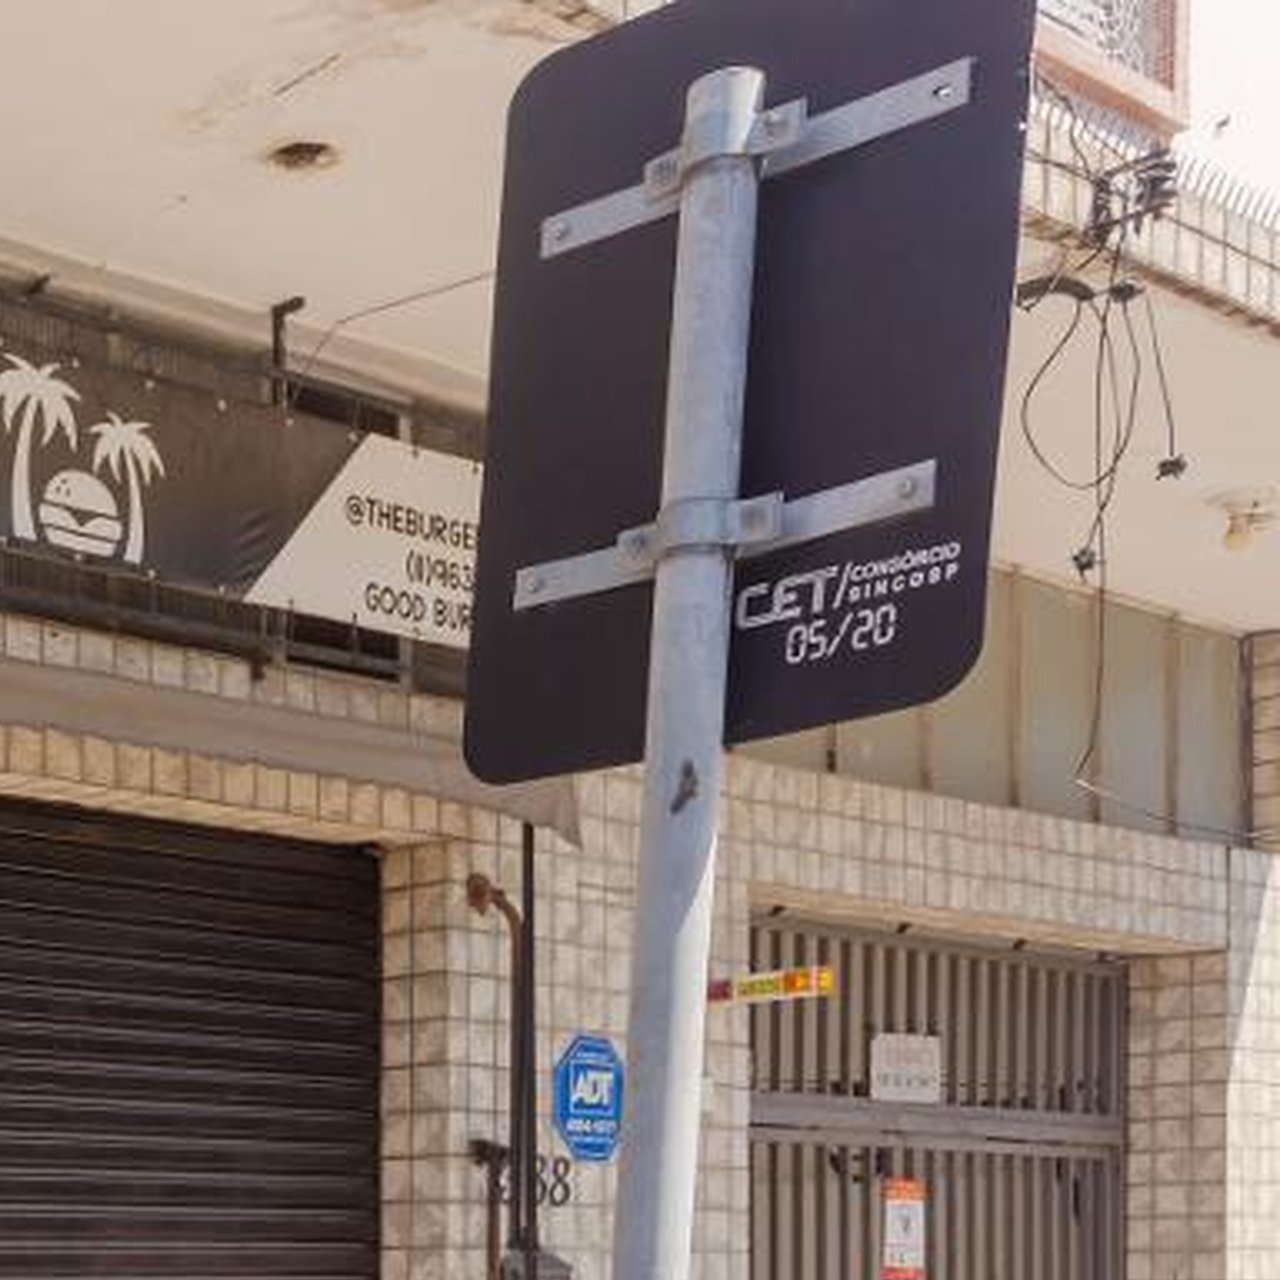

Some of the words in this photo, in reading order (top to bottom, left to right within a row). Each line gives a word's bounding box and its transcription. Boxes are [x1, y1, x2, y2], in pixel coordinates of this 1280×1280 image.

[345, 495, 481, 550] @THEBURGE
[365, 582, 427, 622] GOOD
[785, 603, 898, 664] 05/20
[571, 1071, 614, 1106] ADT
